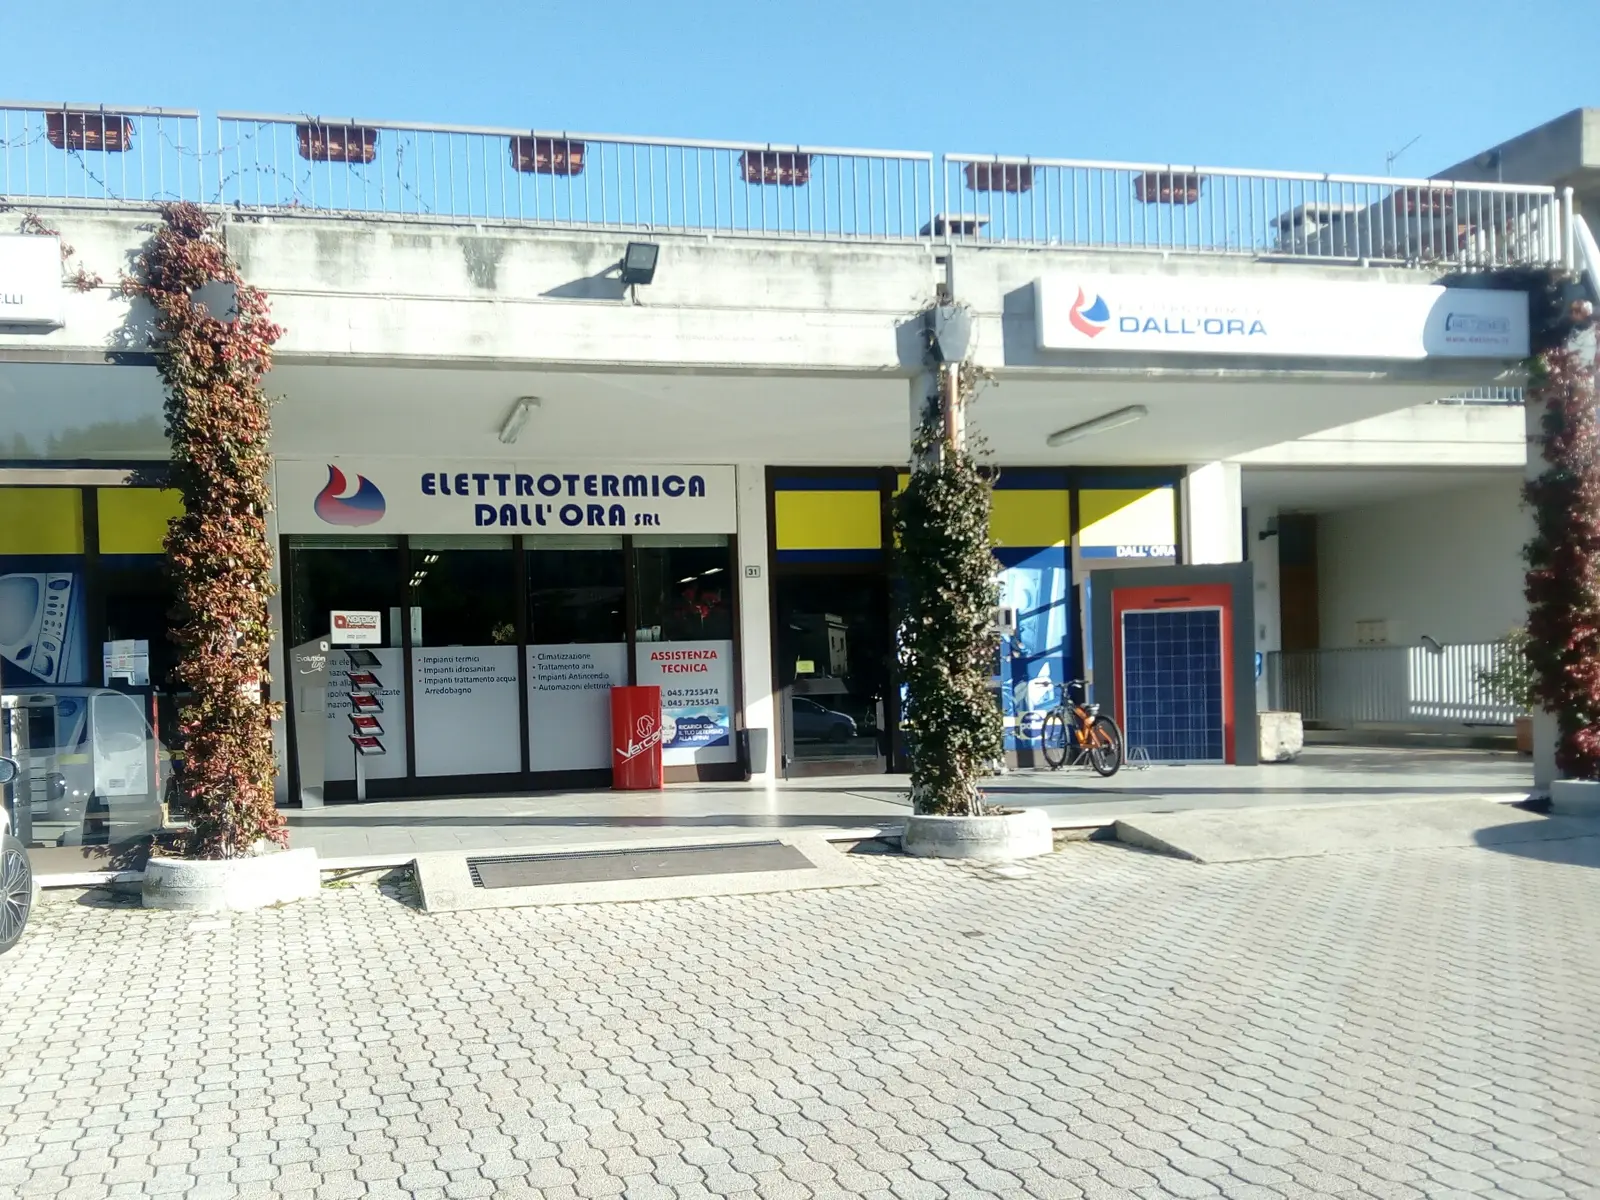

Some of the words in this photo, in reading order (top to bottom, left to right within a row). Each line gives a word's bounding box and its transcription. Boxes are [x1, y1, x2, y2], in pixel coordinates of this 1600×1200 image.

[1119, 316, 1267, 335] DALL'ORA
[421, 473, 706, 497] ELETTROTERMICA
[475, 503, 626, 527] DALL'ORA
[634, 513, 661, 526] SRL
[748, 568, 757, 576] 31
[423, 656, 454, 664] Impianti
[455, 655, 480, 663] termici
[537, 653, 591, 661] Climatizzazione
[651, 650, 718, 661] ASSISTENZA
[423, 667, 454, 675] Impianti
[537, 663, 580, 671] Trattamento
[581, 662, 594, 670] aria
[661, 663, 708, 673] TECNICA
[424, 677, 453, 685] Impianti
[495, 675, 517, 684] acqua
[538, 673, 567, 682] Impianti
[568, 672, 609, 680] Antincendio
[425, 687, 472, 695] Arredobagno
[538, 683, 583, 691] Automazioni
[667, 688, 719, 697] 045.7255474
[667, 698, 720, 707] 045.7255543
